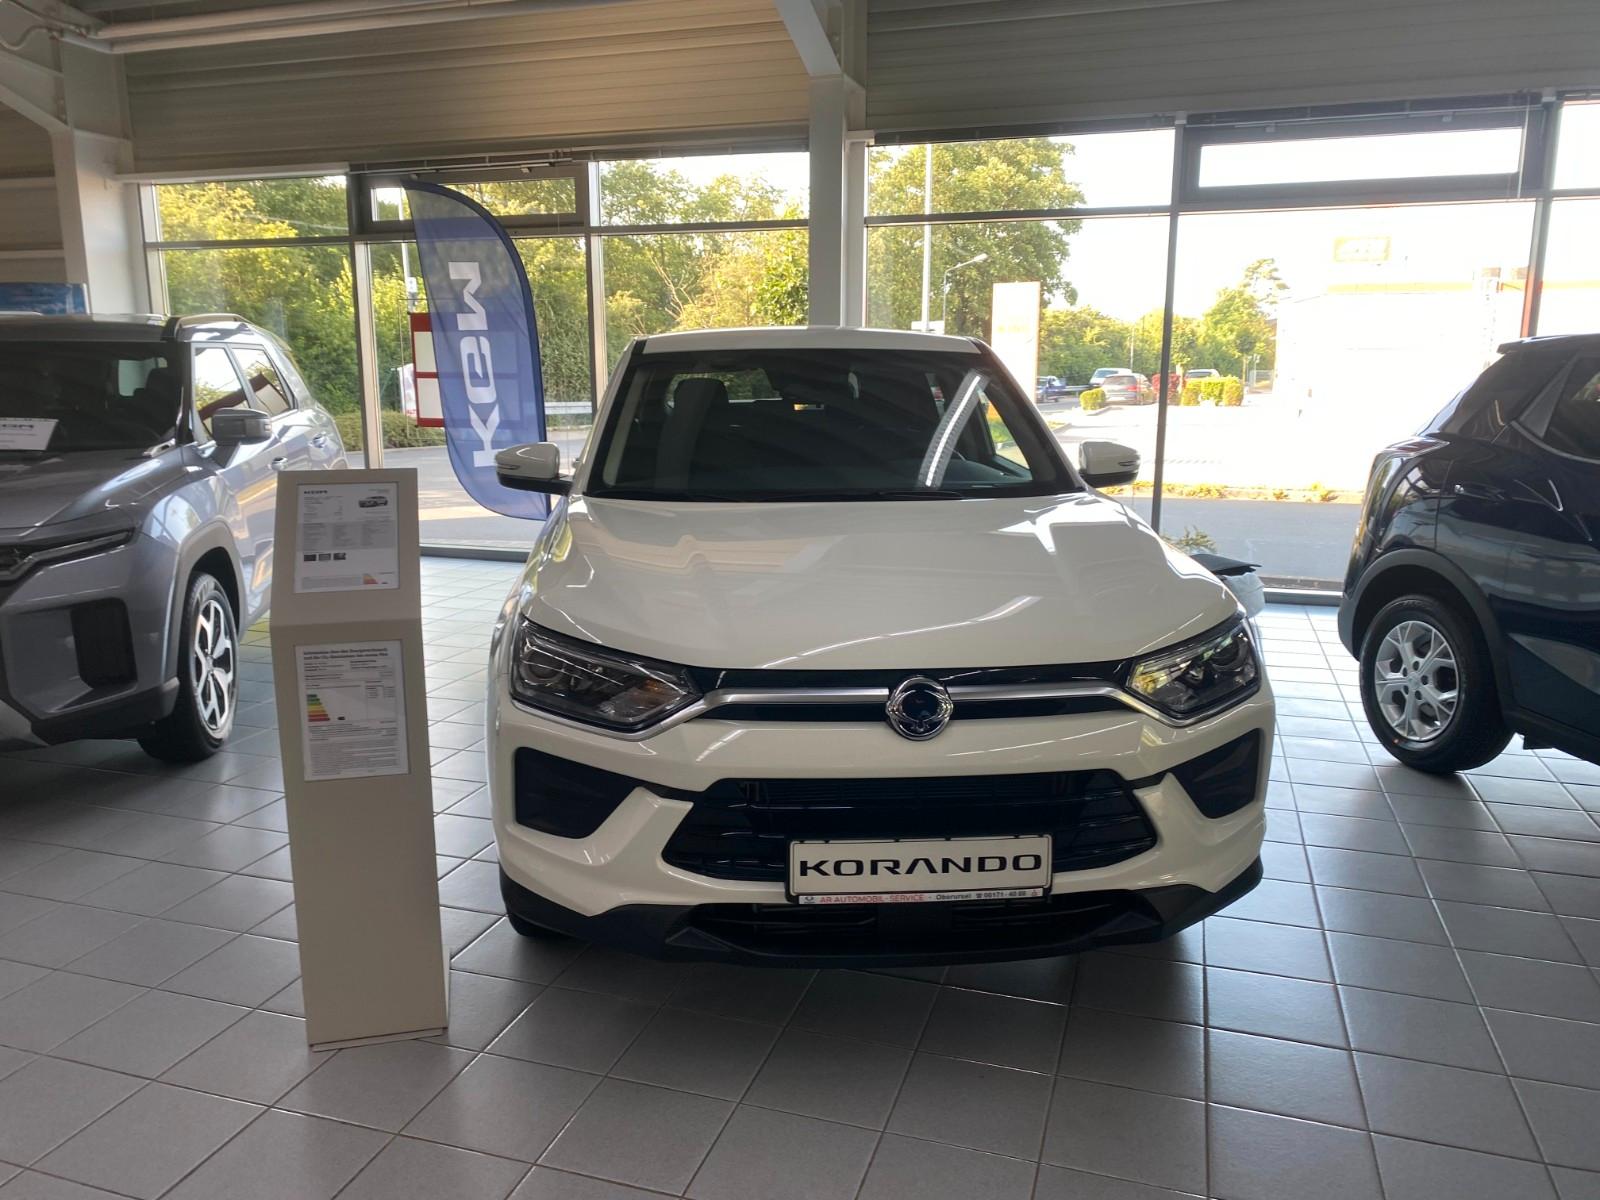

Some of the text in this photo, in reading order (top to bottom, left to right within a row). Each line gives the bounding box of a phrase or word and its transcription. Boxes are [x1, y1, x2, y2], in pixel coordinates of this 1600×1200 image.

[448, 261, 502, 467] KGM
[799, 854, 1042, 877] KORANDO
[833, 895, 884, 903] AUTOMOBIL
[889, 894, 924, 902] SERVICE
